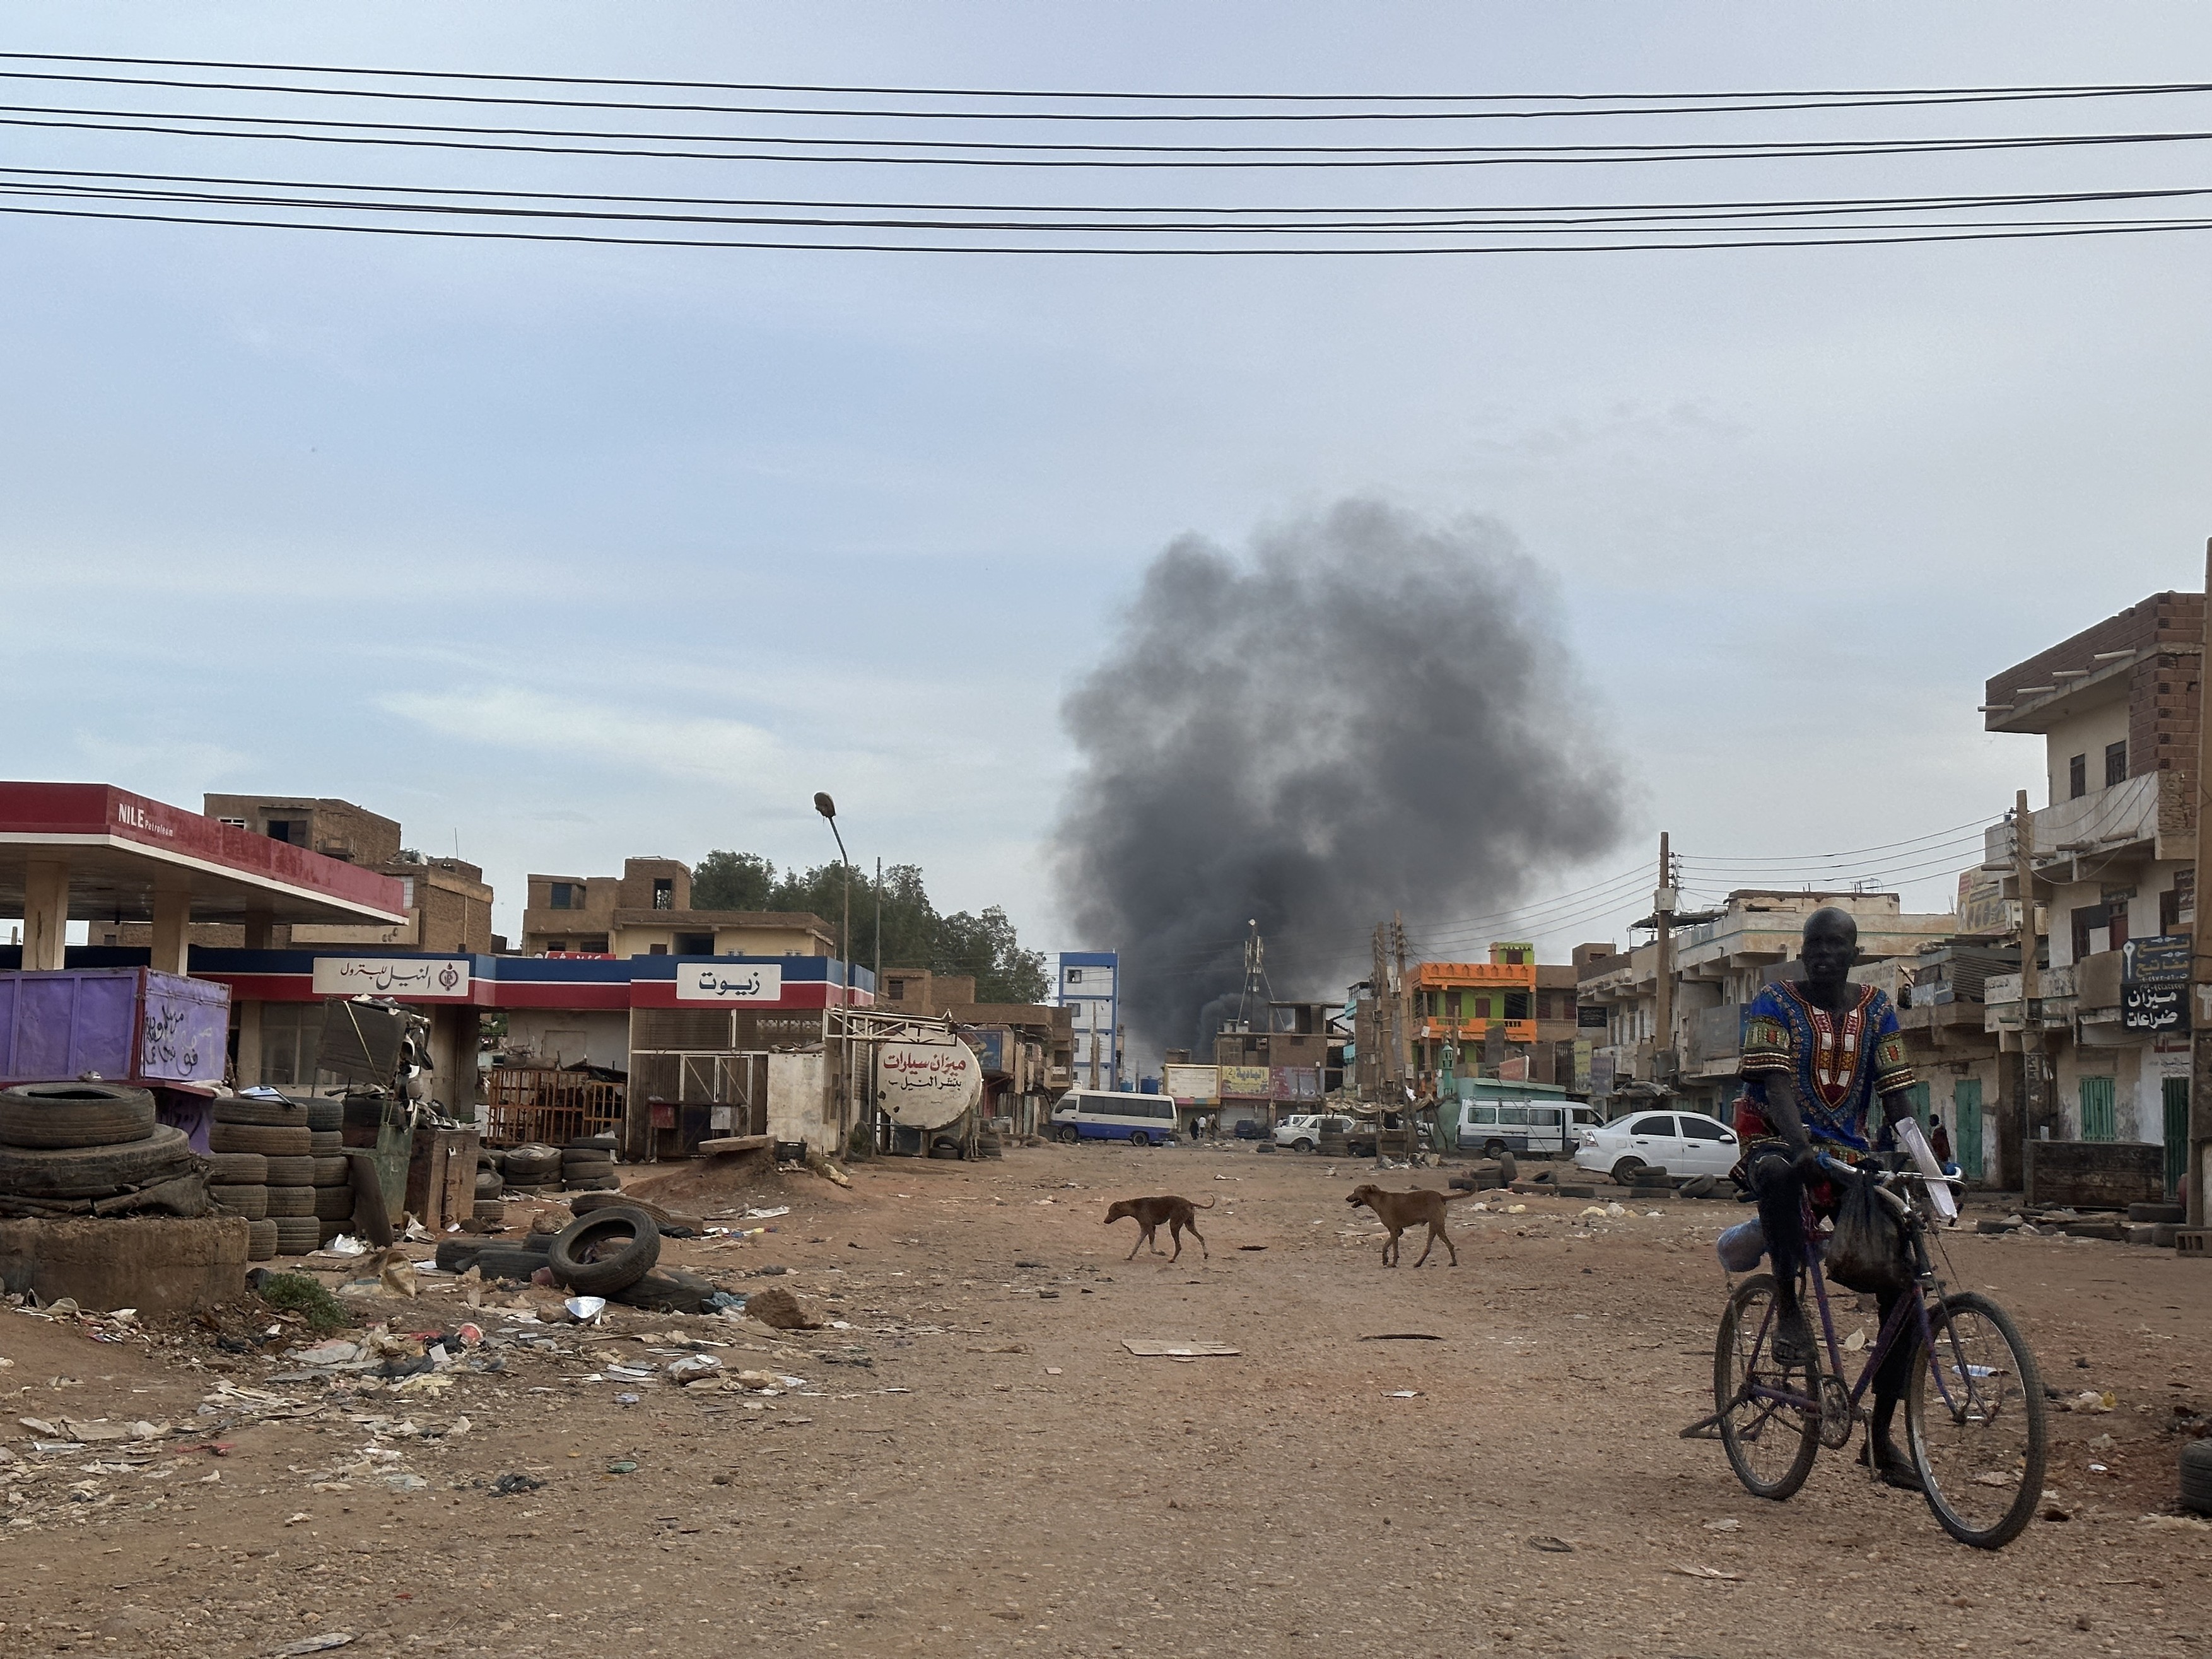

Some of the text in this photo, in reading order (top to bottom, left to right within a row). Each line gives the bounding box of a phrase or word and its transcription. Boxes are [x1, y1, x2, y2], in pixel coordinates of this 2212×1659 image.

[119, 803, 173, 837] NILE Petroleum
[340, 962, 431, 990] النيل للبترول
[2136, 959, 2189, 978] مفاتيح
[699, 971, 760, 995] زيوت
[2127, 988, 2177, 1009] ميزان
[2126, 1009, 2179, 1029] ضراعات
[884, 1050, 966, 1076] ميزان سيارات
[901, 1076, 937, 1091] النيل
